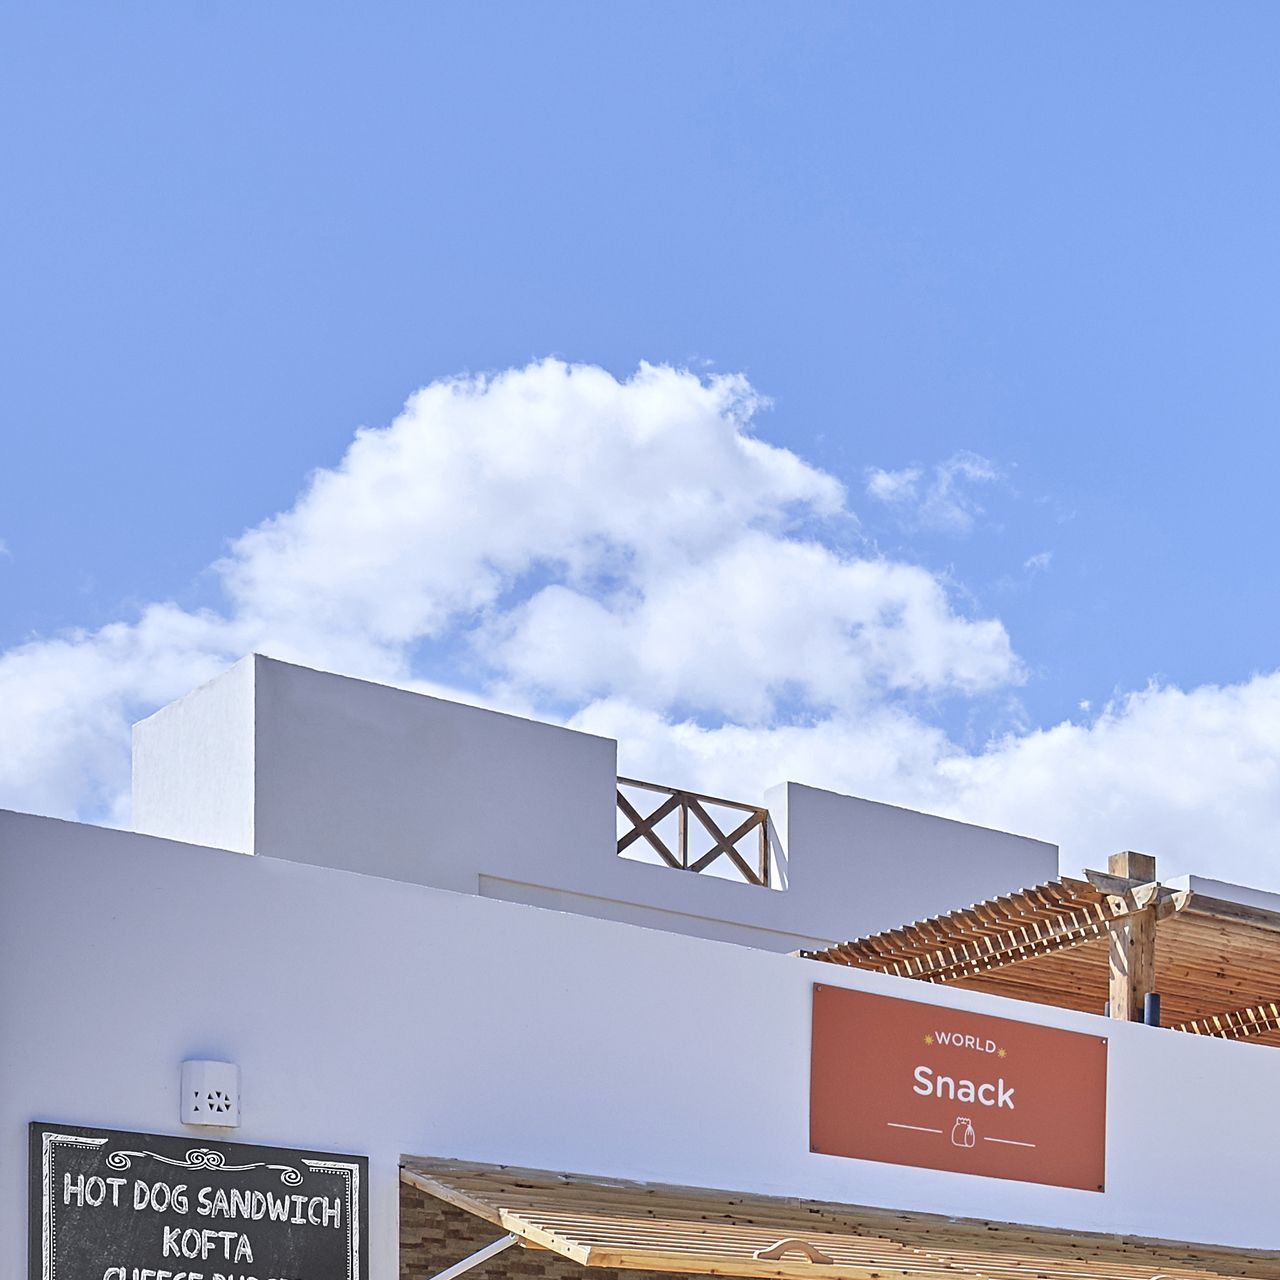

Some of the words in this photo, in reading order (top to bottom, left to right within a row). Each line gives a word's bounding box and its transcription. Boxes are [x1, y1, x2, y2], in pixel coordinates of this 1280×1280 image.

[935, 1031, 996, 1053] WORLD
[912, 1066, 1015, 1110] Snack
[63, 1173, 127, 1207] HOT
[134, 1180, 188, 1214] DOG
[197, 1187, 341, 1228] SANDWICH
[163, 1226, 253, 1263] KOFTA
